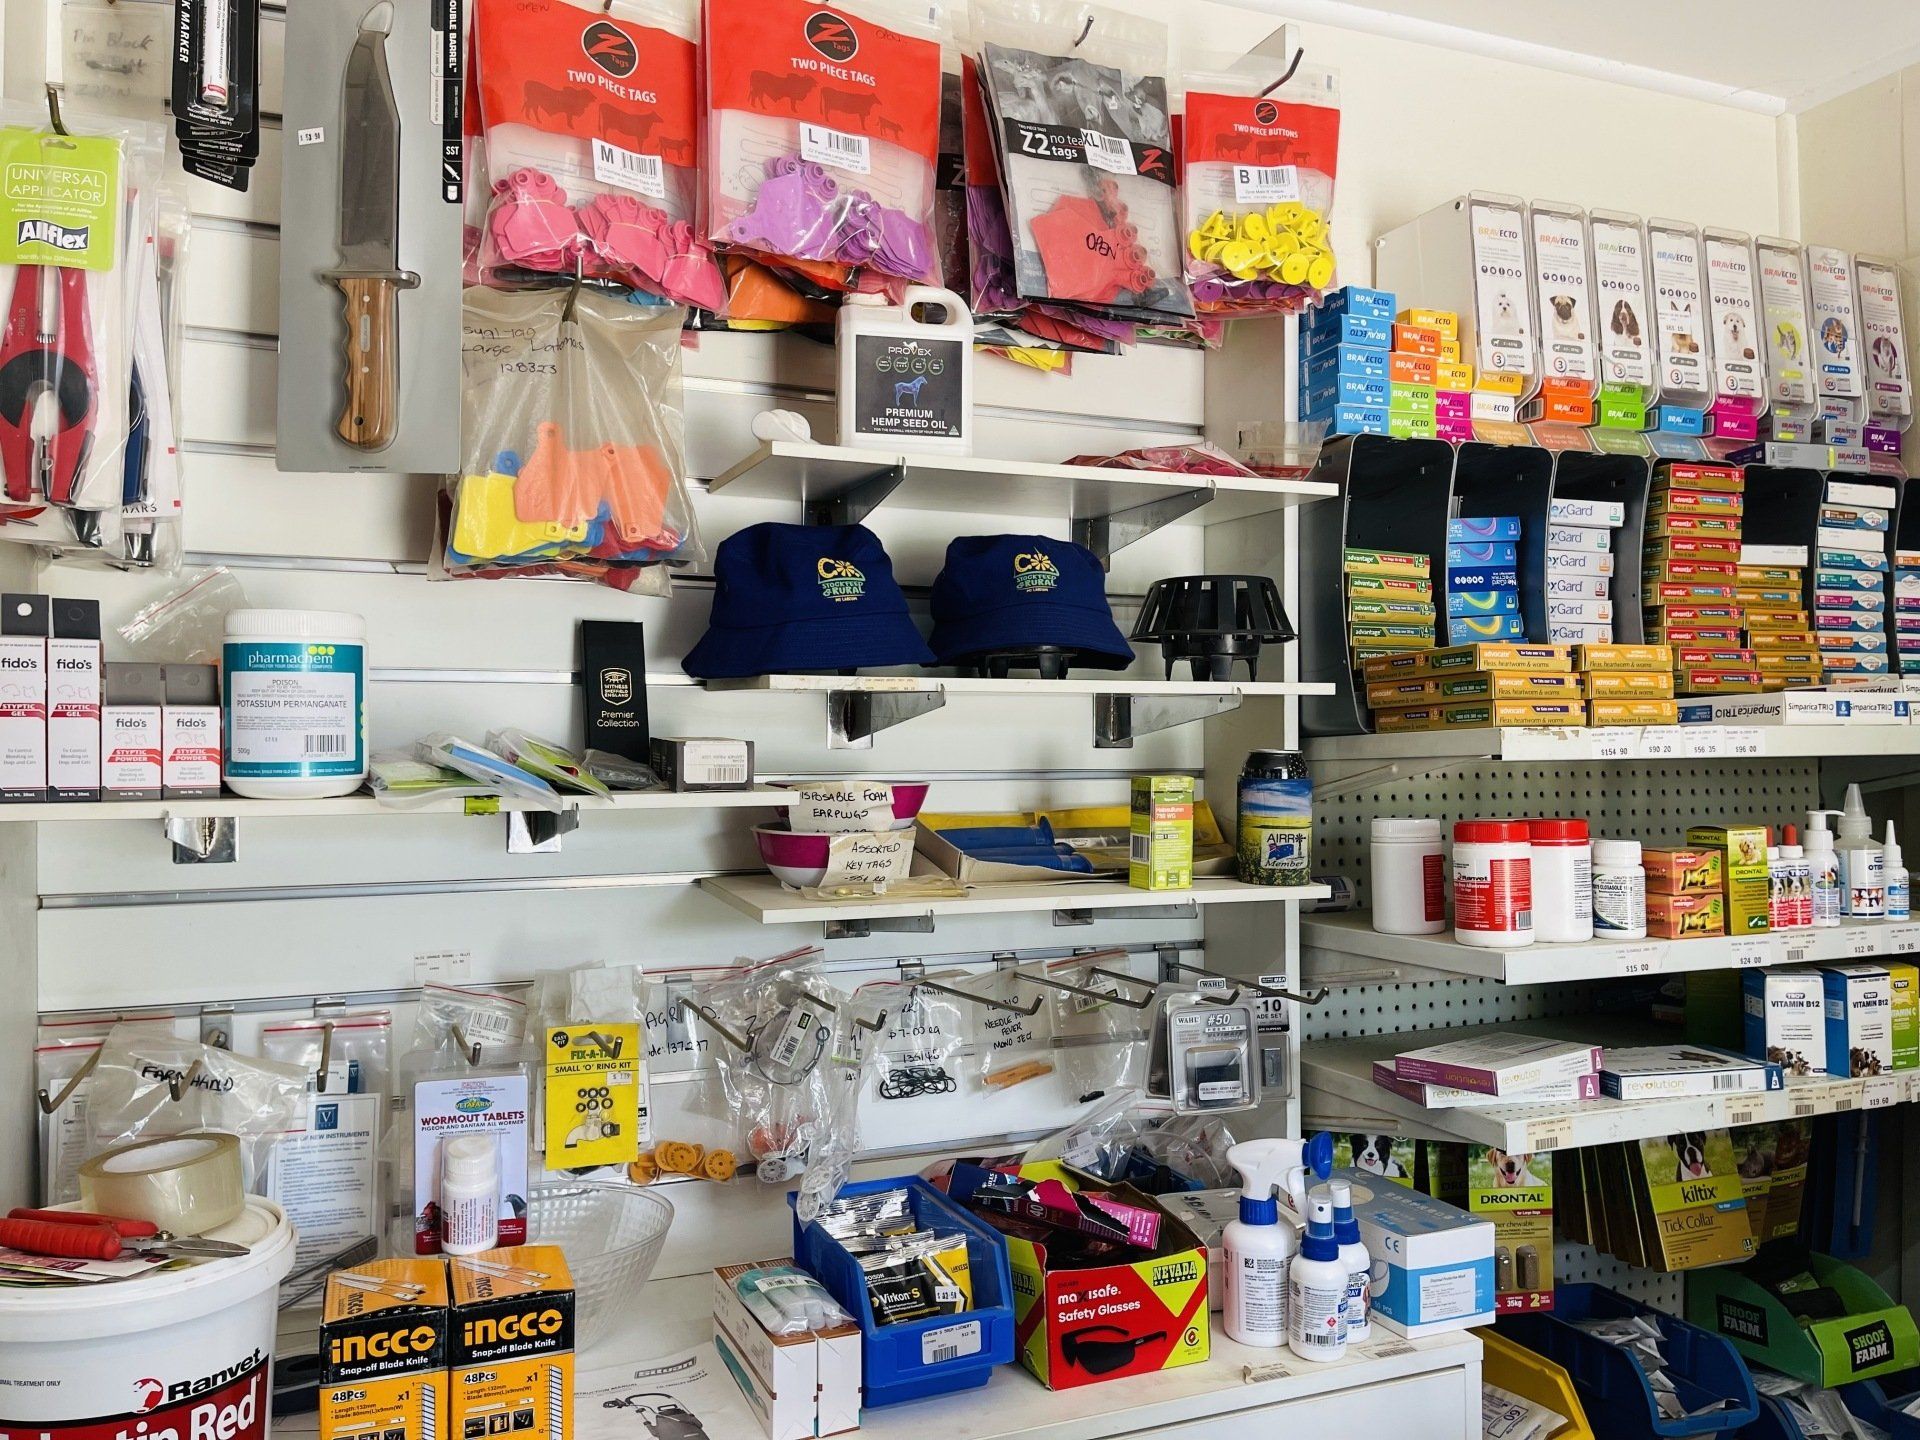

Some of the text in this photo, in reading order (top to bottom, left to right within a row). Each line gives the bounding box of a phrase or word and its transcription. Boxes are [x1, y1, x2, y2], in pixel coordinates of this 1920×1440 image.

[179, 15, 191, 63] MARKER
[791, 58, 876, 86] TWO PIECE TAGS
[567, 70, 656, 103] TWO PIECE TAGS
[808, 128, 818, 144] L
[1234, 124, 1298, 138] TWO PIECE BUTTONS
[1020, 130, 1050, 155] Z2
[1050, 134, 1083, 146] no tea
[1082, 132, 1099, 148] XL
[446, 146, 459, 155] SST
[601, 145, 614, 165] M
[1052, 146, 1077, 159] tags
[12, 168, 101, 187] UNIVERSAL
[1240, 170, 1250, 184] B
[11, 185, 101, 201] APPLICATOR
[20, 225, 87, 249] Allflex
[1478, 227, 1517, 239] BRAVECTO
[1086, 233, 1117, 260] OPEN
[1540, 234, 1579, 247] BRAVECTO
[1598, 243, 1636, 255] BRAVECTO
[1657, 251, 1693, 263] BRAVECTO
[1712, 259, 1746, 272] BRAVECTO
[1814, 264, 1845, 275] BRAVECTO
[1764, 268, 1797, 280] BRAVECTO
[1403, 331, 1435, 343] BRAVECTO
[888, 347, 931, 356] PROVEX
[1347, 354, 1383, 365] BRAVECTO
[1396, 360, 1430, 371] BRAVECTO
[1346, 382, 1383, 393] BRAVECTO
[1392, 389, 1428, 400] BRAVECTO
[886, 408, 933, 418] PREMIUM
[872, 418, 947, 429] HEMP SEED OIL
[1348, 554, 1374, 563] advantage
[1026, 579, 1058, 587] RURAL
[1354, 579, 1379, 588] advantage
[1355, 605, 1381, 613] advantage
[1, 658, 37, 669] fido's
[56, 658, 92, 670] fido's
[249, 651, 333, 667] pharmachem
[237, 700, 347, 708] POTASSIUM PERMANGANATE
[1788, 703, 1817, 711] Simparica
[116, 718, 147, 728] fido's
[176, 718, 206, 728] fido's
[597, 719, 639, 727] Collection
[1601, 748, 1616, 756] $154
[801, 789, 888, 802] ISPOSABLE FOAM
[852, 842, 900, 853] ASSORTED
[845, 859, 892, 870] KEY TAGS
[1740, 956, 1761, 965] $24 00
[1626, 964, 1637, 972] $15
[1853, 1000, 1877, 1008] VITAMIN
[1207, 1014, 1231, 1026] #50
[1002, 1022, 1022, 1035] FEVER
[1627, 1079, 1686, 1090] revolution
[456, 1101, 492, 1109] VETAFARM
[421, 1111, 524, 1126] WORMOUT TABLETS
[326, 1131, 369, 1139] INSTRUMENTS
[1481, 1194, 1544, 1204] DRONTAL
[1682, 1183, 1717, 1204] kiltix
[1664, 1214, 1714, 1234] Tick Collar
[1153, 1261, 1196, 1279] NEVADA
[865, 1273, 884, 1281] POISON
[880, 1288, 920, 1304] Virkon S
[1530, 1294, 1540, 1307] 2
[1058, 1300, 1141, 1323] Safety Glasses
[1722, 1304, 1760, 1323] SHOOF
[1853, 1329, 1885, 1350] SHOOF
[472, 1338, 555, 1358] Snap-off Blade Knife
[340, 1355, 428, 1376] Snap-off Blade Knife
[168, 1347, 261, 1401] Ranvet
[464, 1371, 497, 1385] 48Pcs
[526, 1371, 538, 1382] x1
[332, 1389, 367, 1403] 48Pcs
[398, 1390, 410, 1401] x1
[190, 1375, 256, 1440] Red
